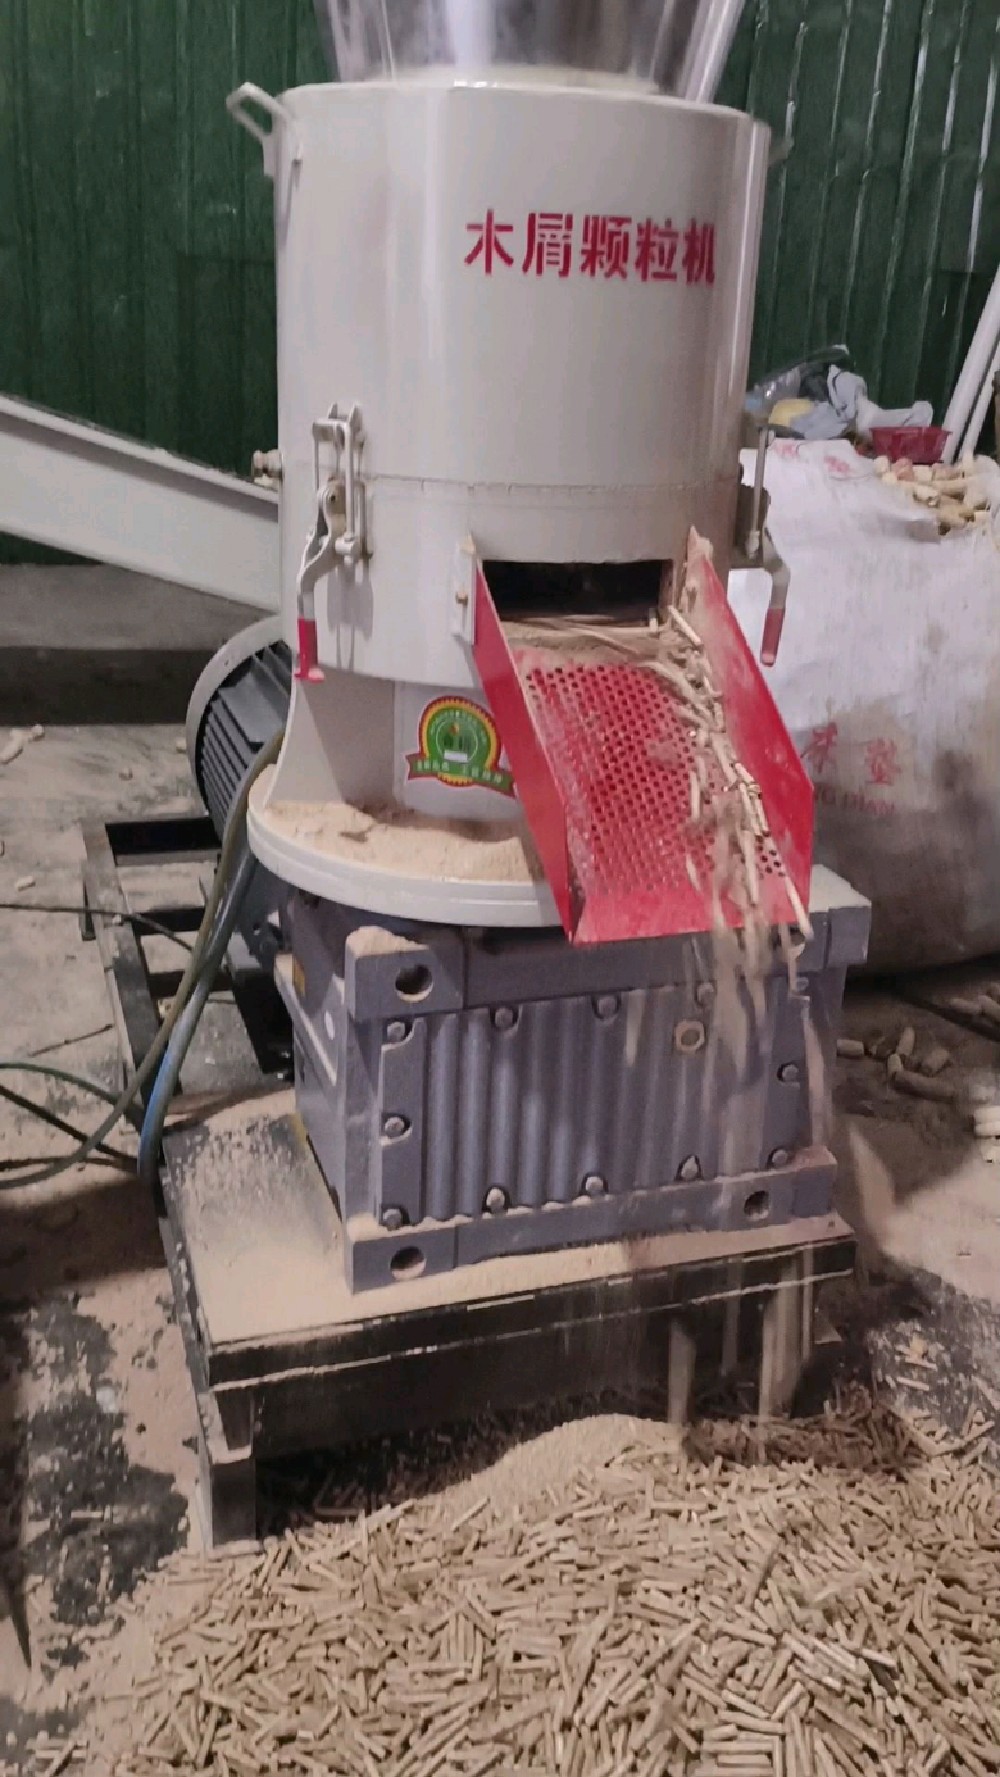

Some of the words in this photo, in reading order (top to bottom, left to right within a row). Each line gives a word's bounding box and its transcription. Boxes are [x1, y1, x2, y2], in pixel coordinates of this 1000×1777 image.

[464, 208, 715, 285] 木屑颗粒机
